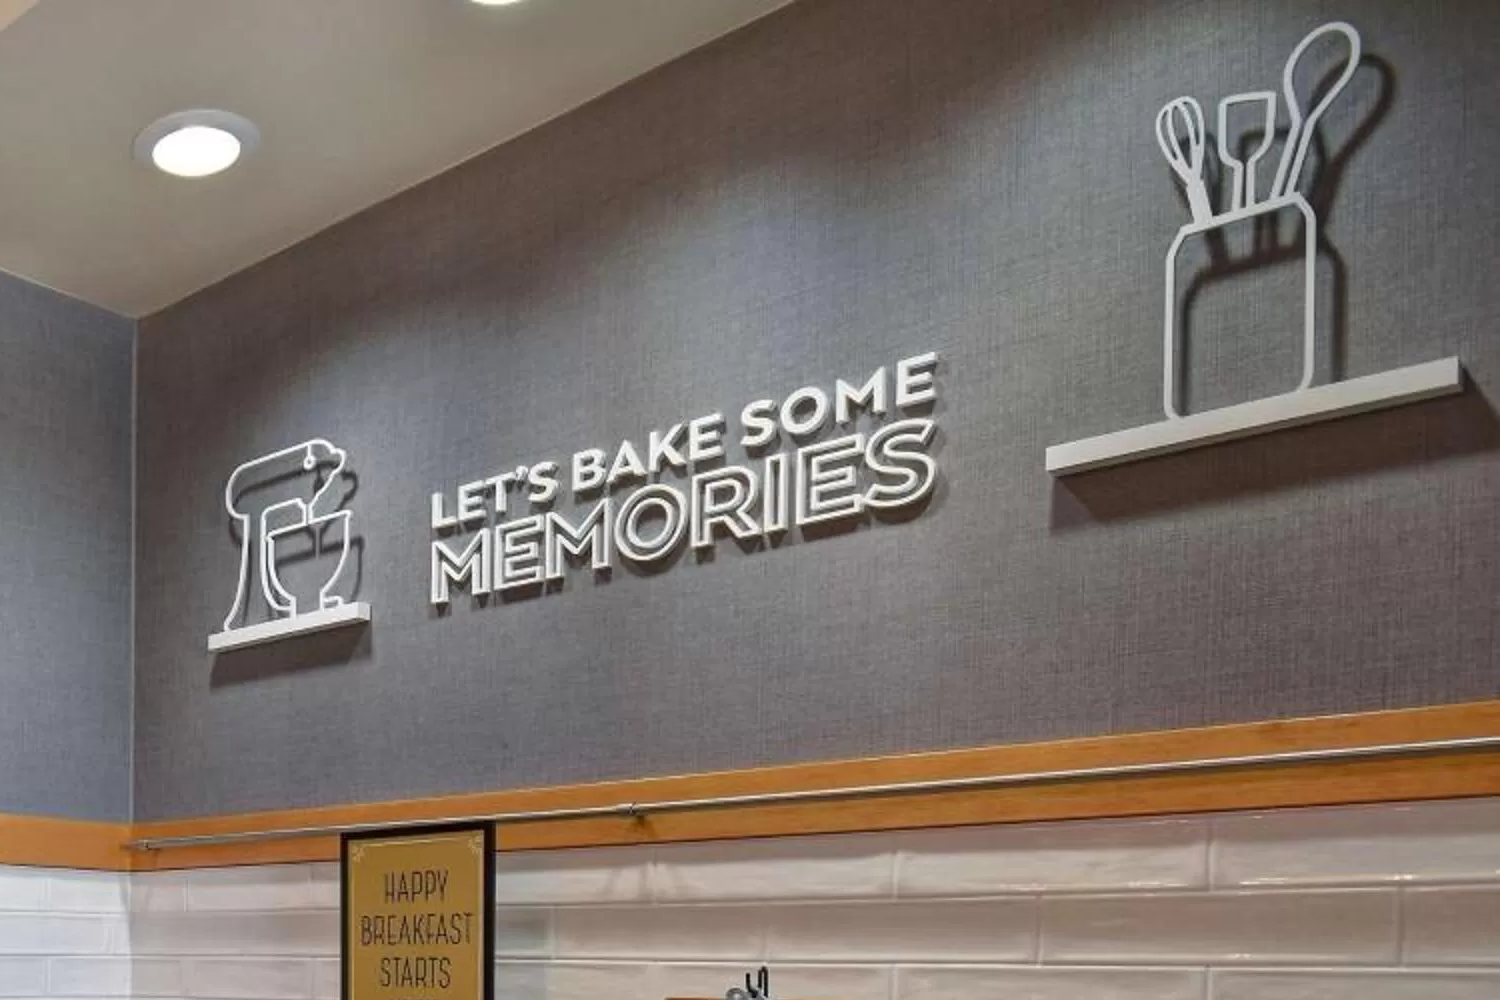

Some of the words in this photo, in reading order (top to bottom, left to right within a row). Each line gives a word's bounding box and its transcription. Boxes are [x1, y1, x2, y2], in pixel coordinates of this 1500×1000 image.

[431, 461, 560, 529] LET'S
[572, 412, 726, 492] BAKE
[740, 352, 938, 447] SOME
[430, 418, 937, 604] MEMORIES
[384, 869, 449, 903] HAPPY
[361, 912, 474, 946] BREAKFAST
[380, 956, 452, 989] STARTS
